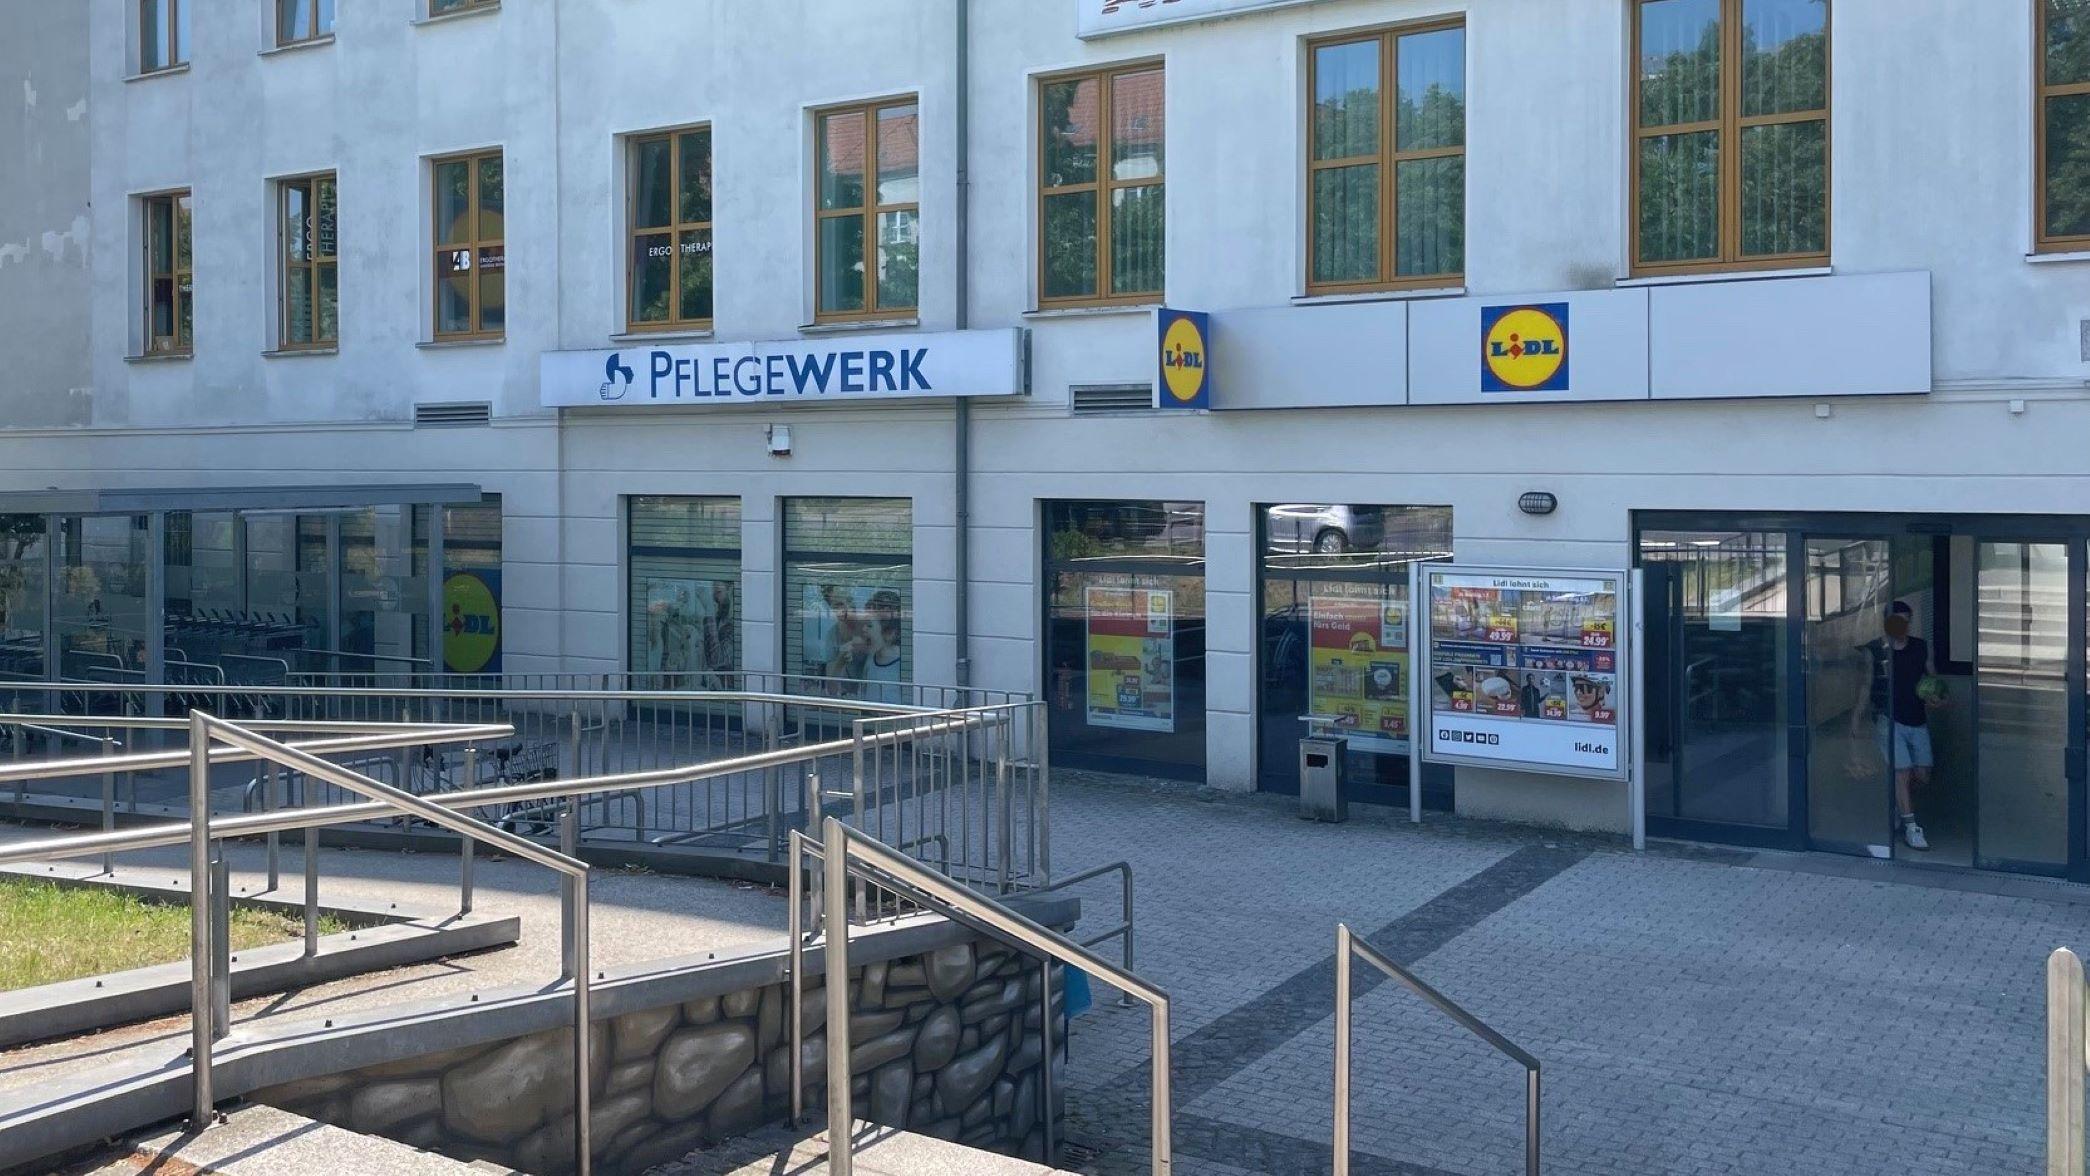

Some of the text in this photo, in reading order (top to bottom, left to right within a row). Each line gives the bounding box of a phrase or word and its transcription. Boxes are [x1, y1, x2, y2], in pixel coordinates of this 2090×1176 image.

[649, 245, 673, 257] ERGO
[650, 348, 932, 398] PFLEGEWERK
[1574, 742, 1609, 755] lidl.de
